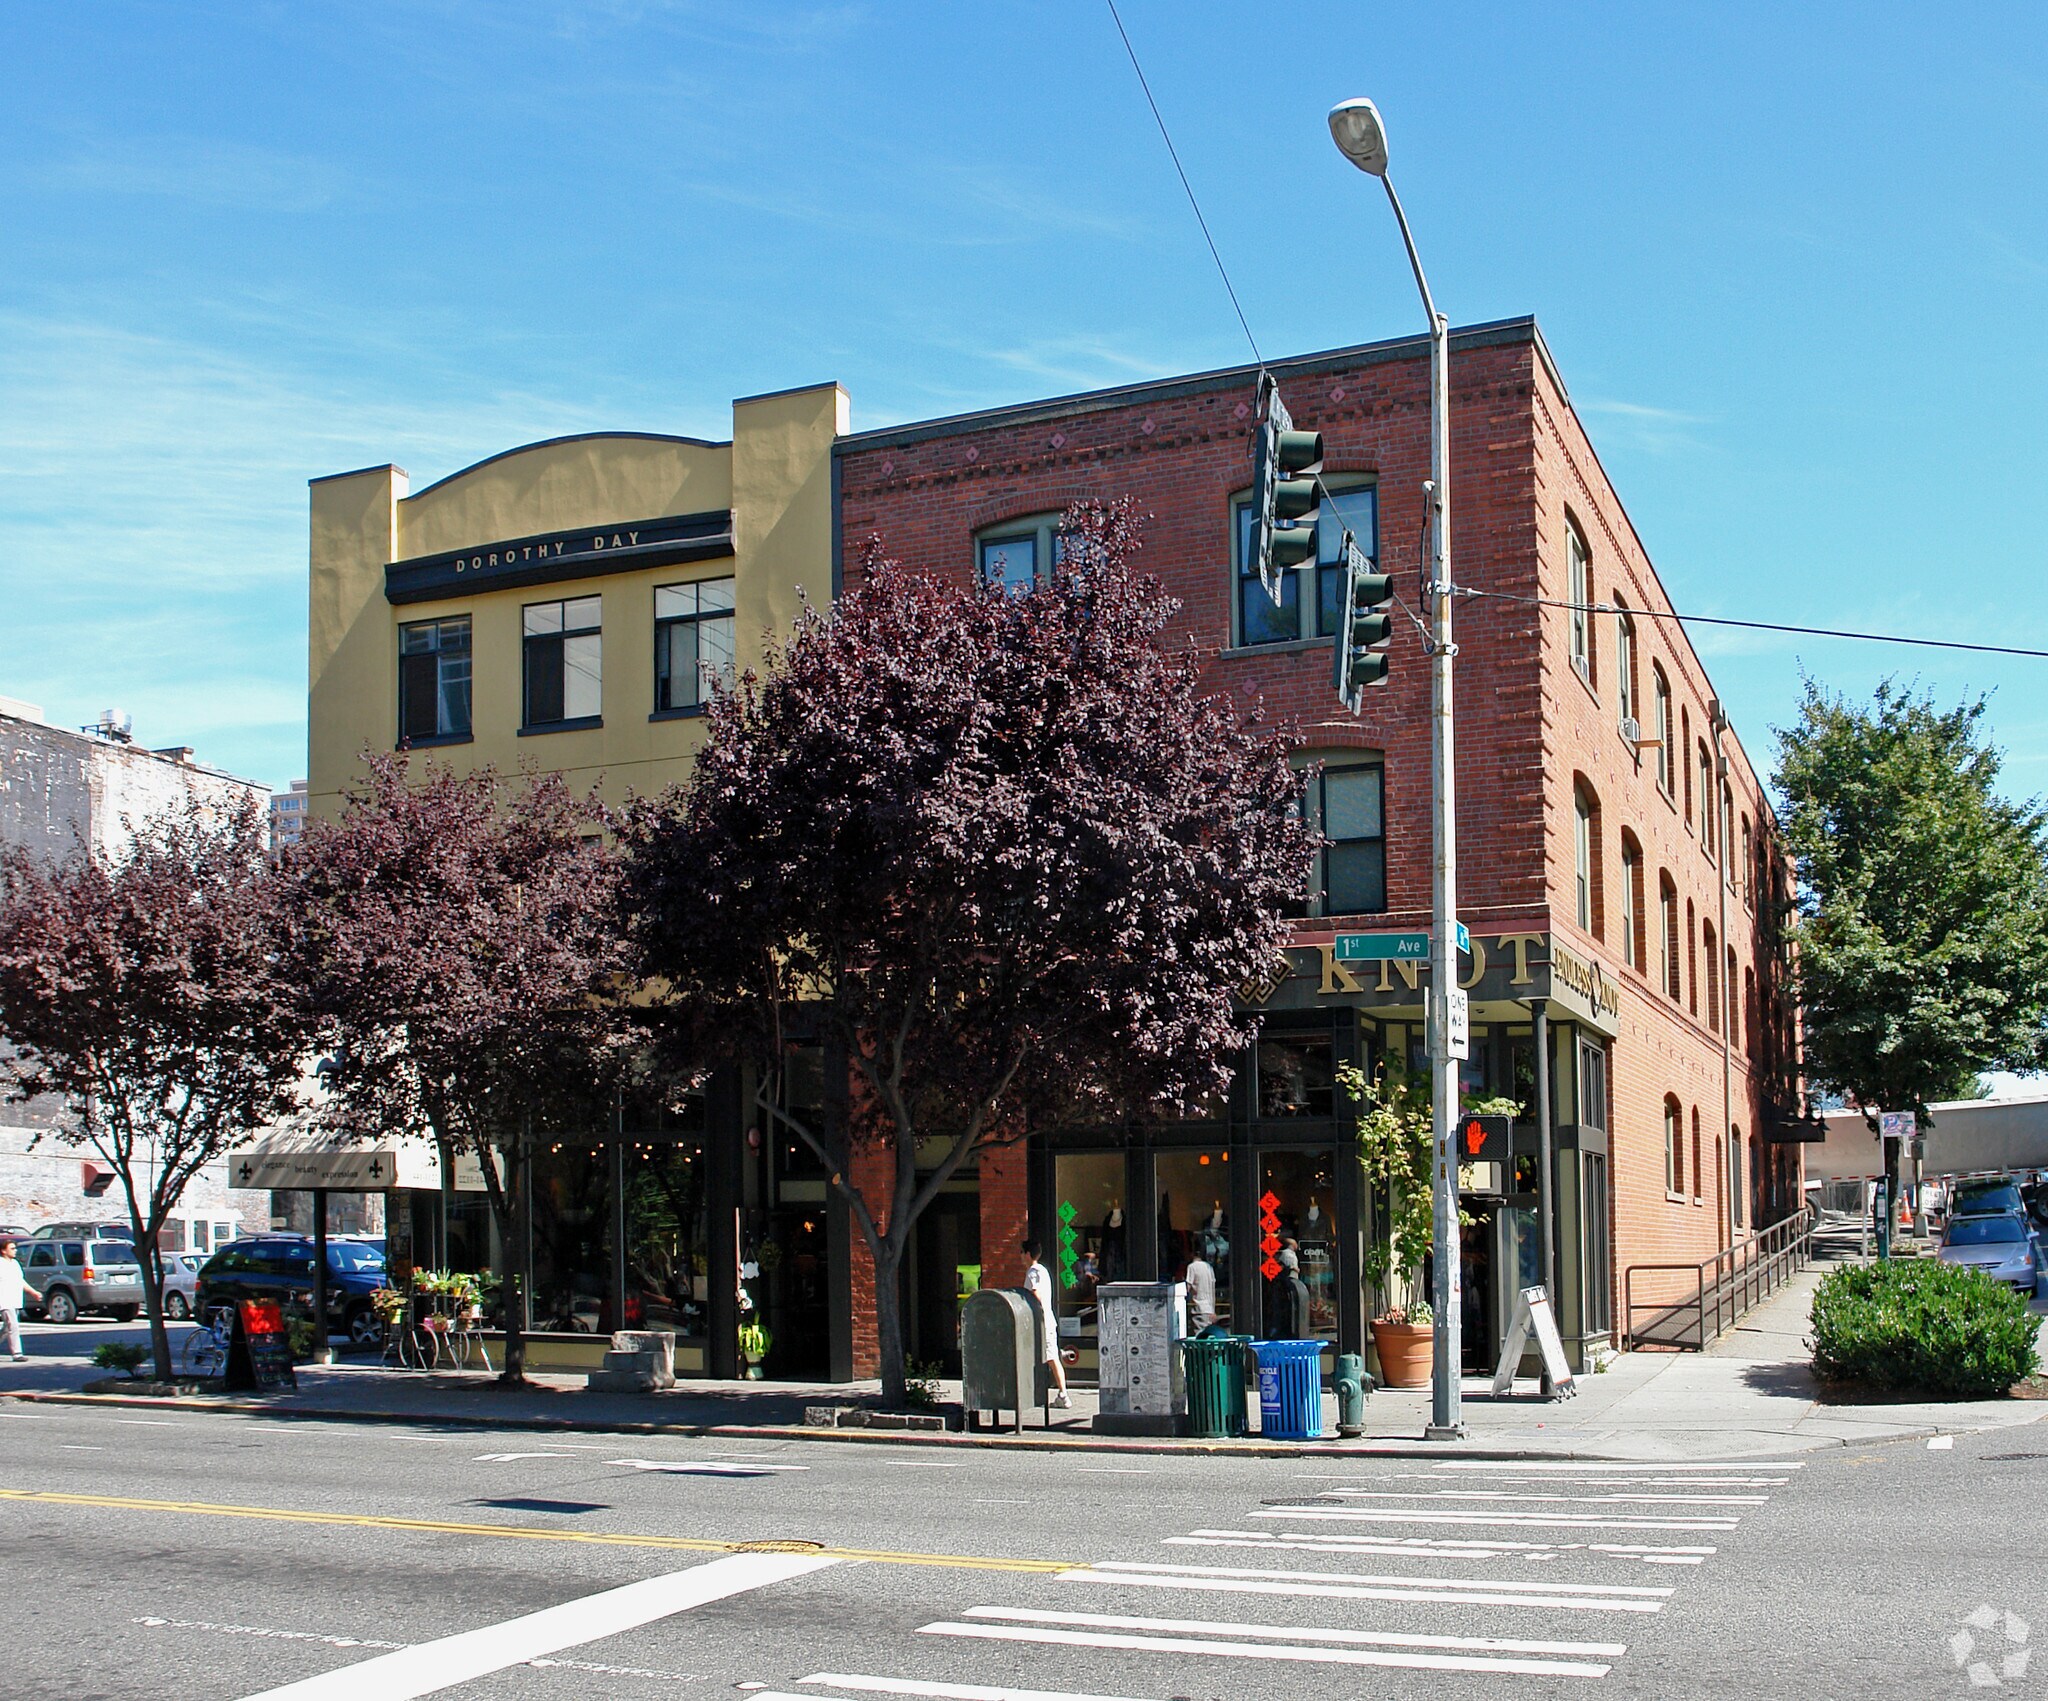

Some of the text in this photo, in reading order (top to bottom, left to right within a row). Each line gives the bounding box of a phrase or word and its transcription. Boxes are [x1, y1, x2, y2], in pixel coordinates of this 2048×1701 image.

[456, 532, 639, 573] DOROTHY DAY
[1343, 938, 1421, 957] 1st Ave
[1450, 1012, 1466, 1028] WA
[262, 1161, 359, 1180] elegance beauty expression
